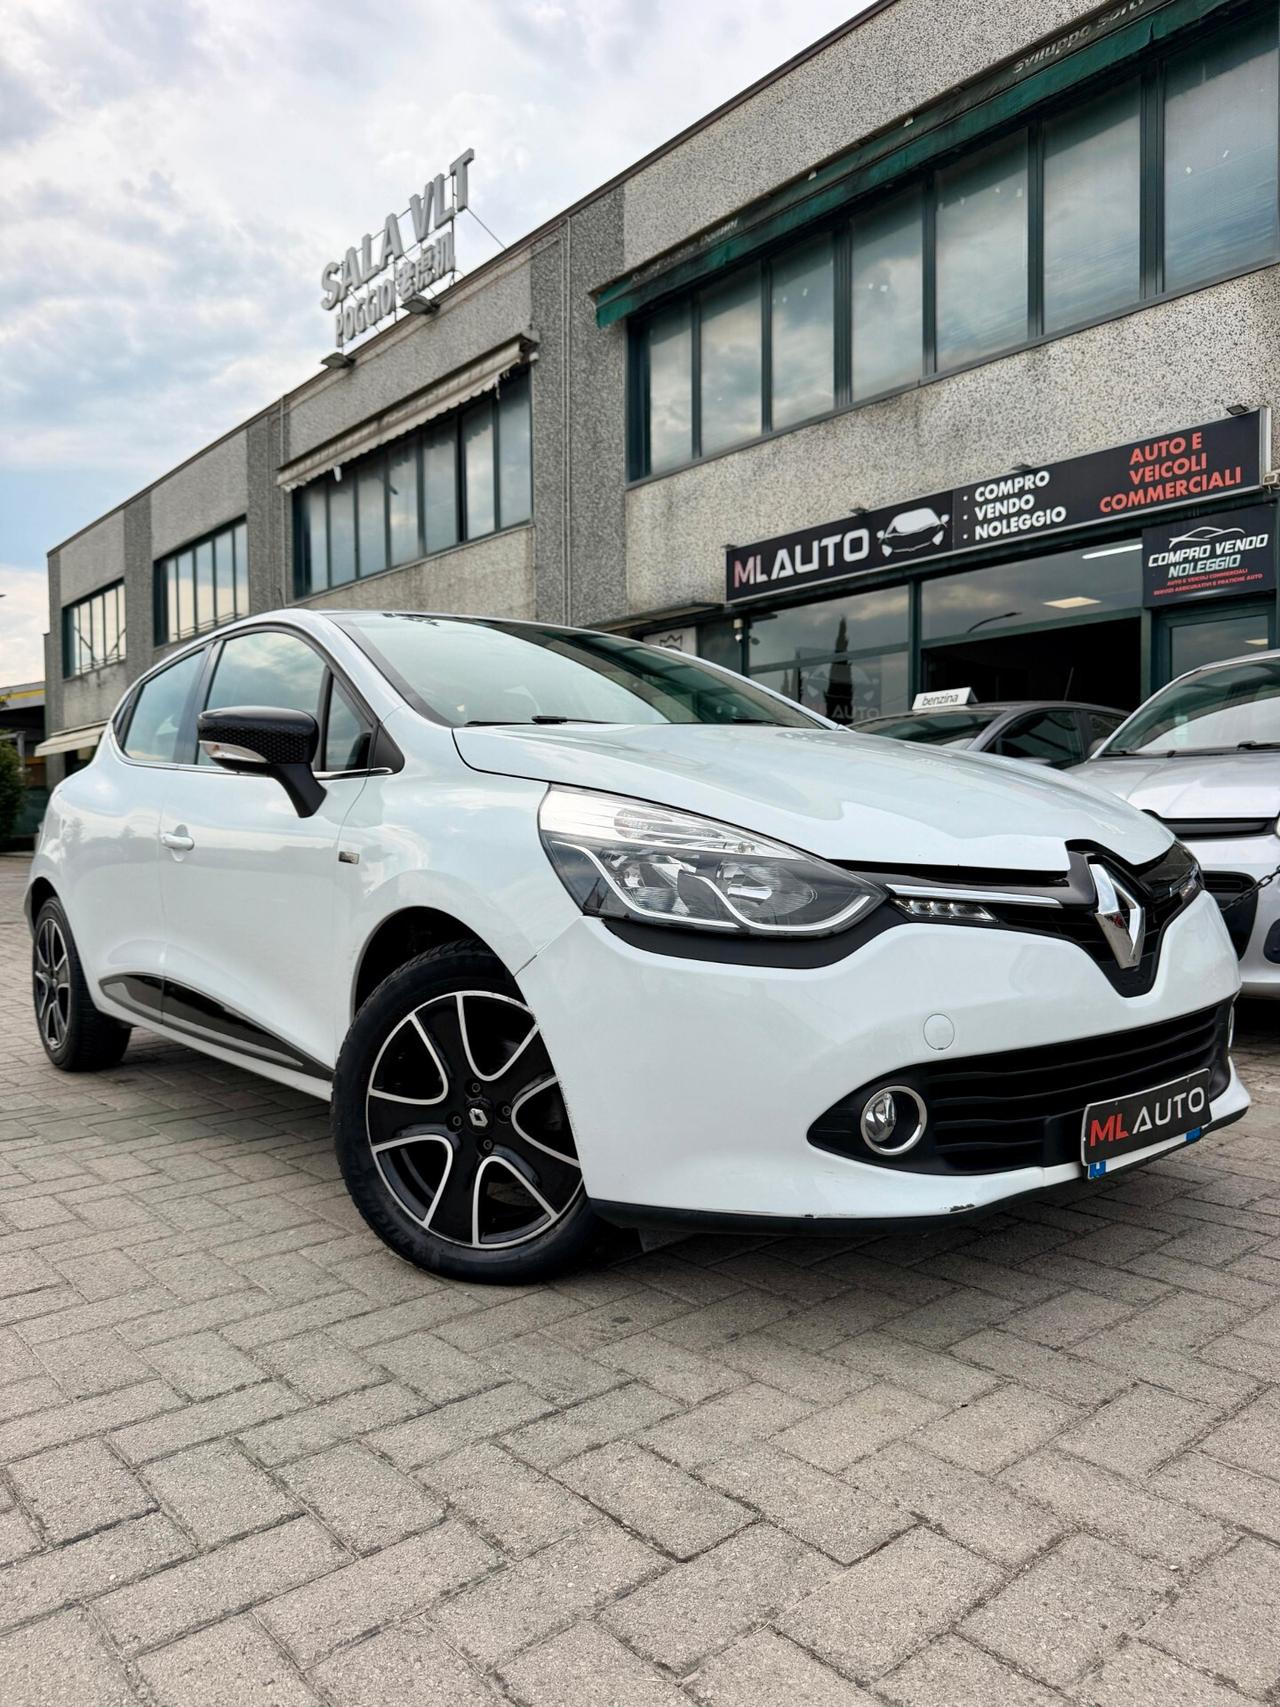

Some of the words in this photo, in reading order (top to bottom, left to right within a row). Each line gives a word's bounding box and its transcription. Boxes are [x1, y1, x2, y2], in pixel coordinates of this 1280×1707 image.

[320, 213, 404, 311] SALA
[409, 147, 475, 243] VLT
[335, 278, 397, 347] POGGIO
[1129, 437, 1186, 465] AUTO
[1191, 432, 1202, 450] E
[1129, 453, 1207, 485] VEICOLI
[974, 470, 1050, 502] COMPRO
[1099, 466, 1242, 513] COMMERCIALI
[974, 494, 1035, 521] VENDO
[974, 506, 1067, 541] NOLEGGIO
[1148, 544, 1211, 567] COMPRO
[1215, 534, 1269, 555] VENDO
[1168, 554, 1241, 578] NOLEGGIO
[1246, 573, 1263, 581] AUTO
[832, 704, 880, 719] AUTO
[922, 692, 959, 706] benzina
